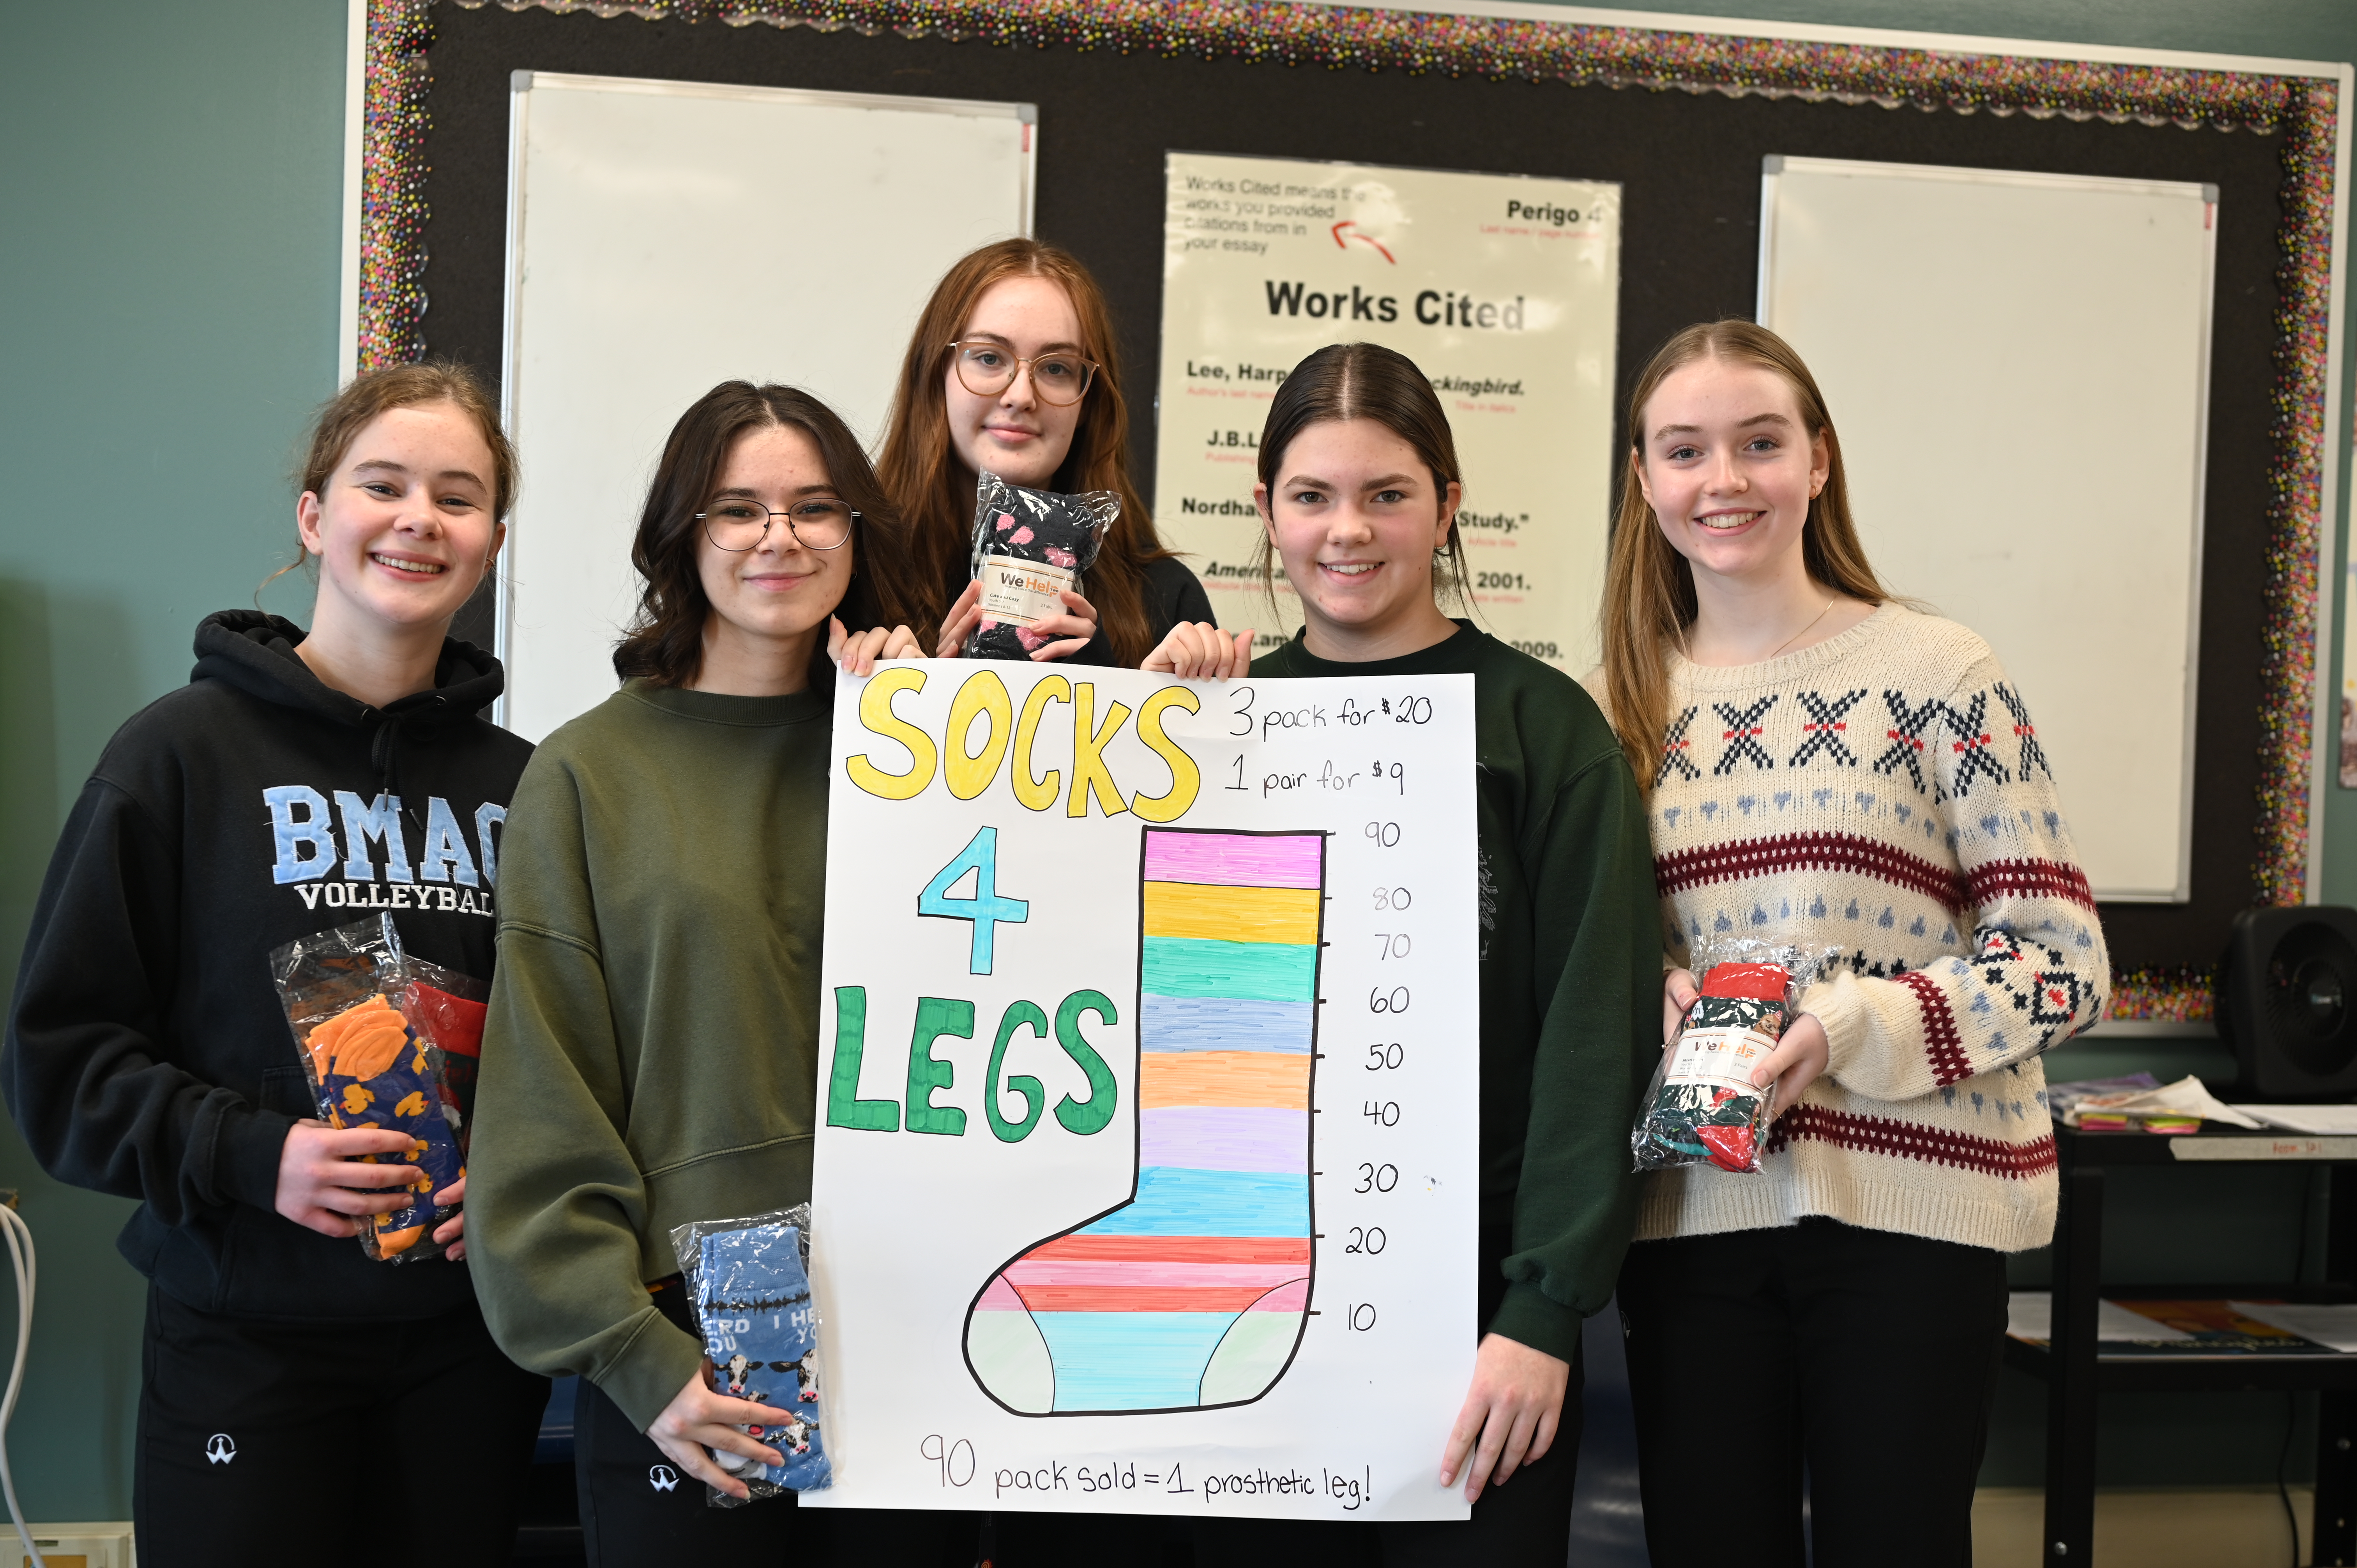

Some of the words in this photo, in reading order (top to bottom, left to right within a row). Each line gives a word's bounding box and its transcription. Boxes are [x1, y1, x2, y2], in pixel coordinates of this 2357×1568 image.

[1186, 176, 1235, 193] Works
[1240, 178, 1281, 196] Cited
[1286, 184, 1337, 200] means
[1186, 198, 1231, 212] works
[1235, 202, 1264, 215] you
[1268, 202, 1335, 219] provided
[1507, 200, 1580, 227] Perigo
[1253, 219, 1288, 234] from
[1293, 221, 1307, 236] in
[1184, 237, 1219, 252] your
[1222, 238, 1269, 256] essay
[1265, 279, 1398, 324] Works
[1415, 290, 1525, 331] Cited
[1187, 360, 1230, 382] Lee,
[1238, 363, 1288, 385] Harp
[1182, 497, 1260, 516] Nordha
[1477, 571, 1531, 590] 2001.
[1230, 687, 1254, 736] 3
[1263, 705, 1326, 742] pack
[1337, 698, 1375, 726] for
[1382, 696, 1432, 724] $20
[846, 667, 1201, 823] SOCKS
[1224, 754, 1249, 790] 1
[1263, 773, 1307, 799] pair
[1316, 759, 1360, 791] for
[1365, 821, 1400, 847] 90
[917, 825, 1029, 976] 4
[1373, 887, 1411, 911] 80
[1374, 934, 1411, 961] 70
[1370, 986, 1410, 1013] 60
[826, 985, 1118, 1143] LEGS
[1365, 1043, 1403, 1071] 50
[1364, 1101, 1400, 1127] 40
[1355, 1163, 1398, 1194] 30
[1345, 1227, 1386, 1255] 20
[1348, 1303, 1376, 1331] 10
[921, 1435, 975, 1487] 90
[995, 1460, 1069, 1499] pack
[1077, 1461, 1136, 1492] sold
[1167, 1462, 1194, 1494] 1
[1204, 1468, 1315, 1503] prosthetic
[1323, 1465, 1370, 1510] leg!
